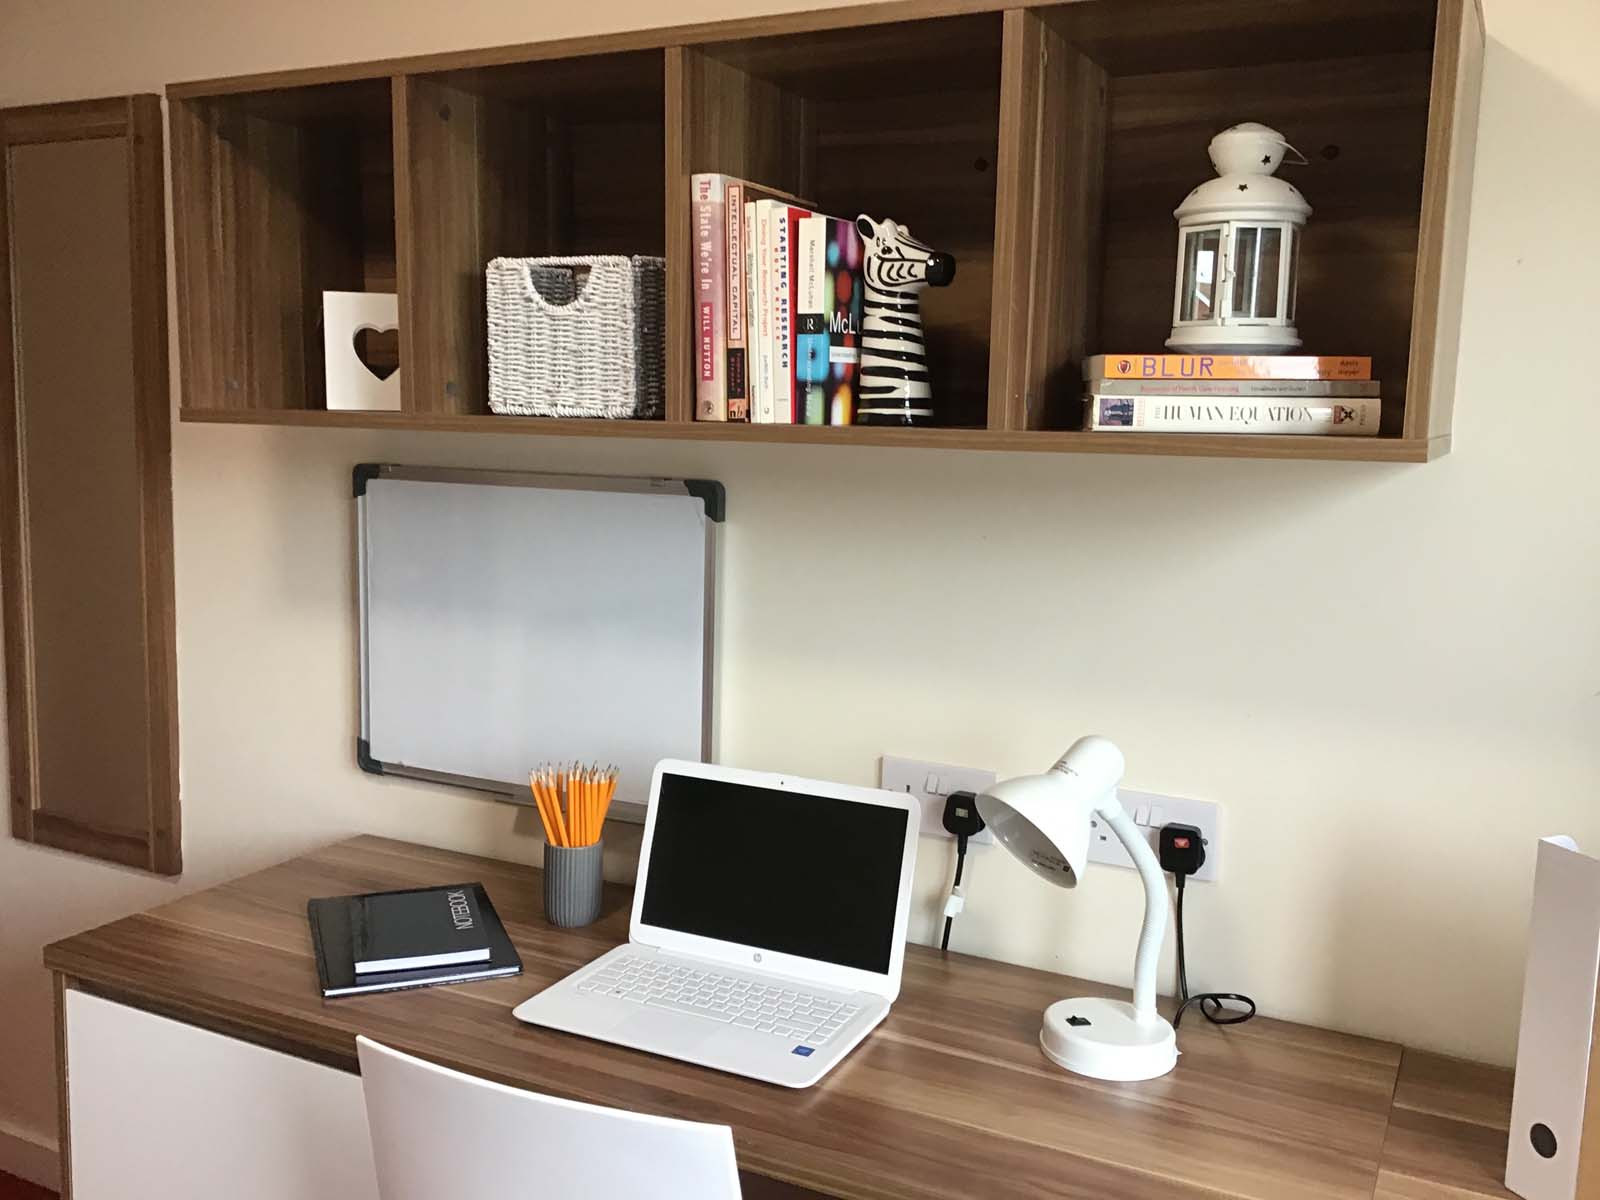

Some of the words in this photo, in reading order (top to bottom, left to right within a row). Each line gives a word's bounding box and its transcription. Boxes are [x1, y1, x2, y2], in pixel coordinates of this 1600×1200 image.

[699, 180, 711, 200] The
[700, 205, 712, 238] State
[730, 195, 738, 280] INTELLECTUAL
[700, 240, 713, 273] We're
[779, 217, 787, 289] STARTING
[700, 279, 713, 290] In
[702, 306, 711, 331] WILL
[731, 286, 739, 333] CAPITAL
[781, 298, 789, 368] RESEARCH
[703, 336, 712, 378] HUTTON
[1142, 357, 1214, 377] BLUR
[1164, 405, 1224, 421] HUMAN
[1230, 405, 1314, 425] EQUATION
[448, 890, 473, 929] NOTEBOOK
